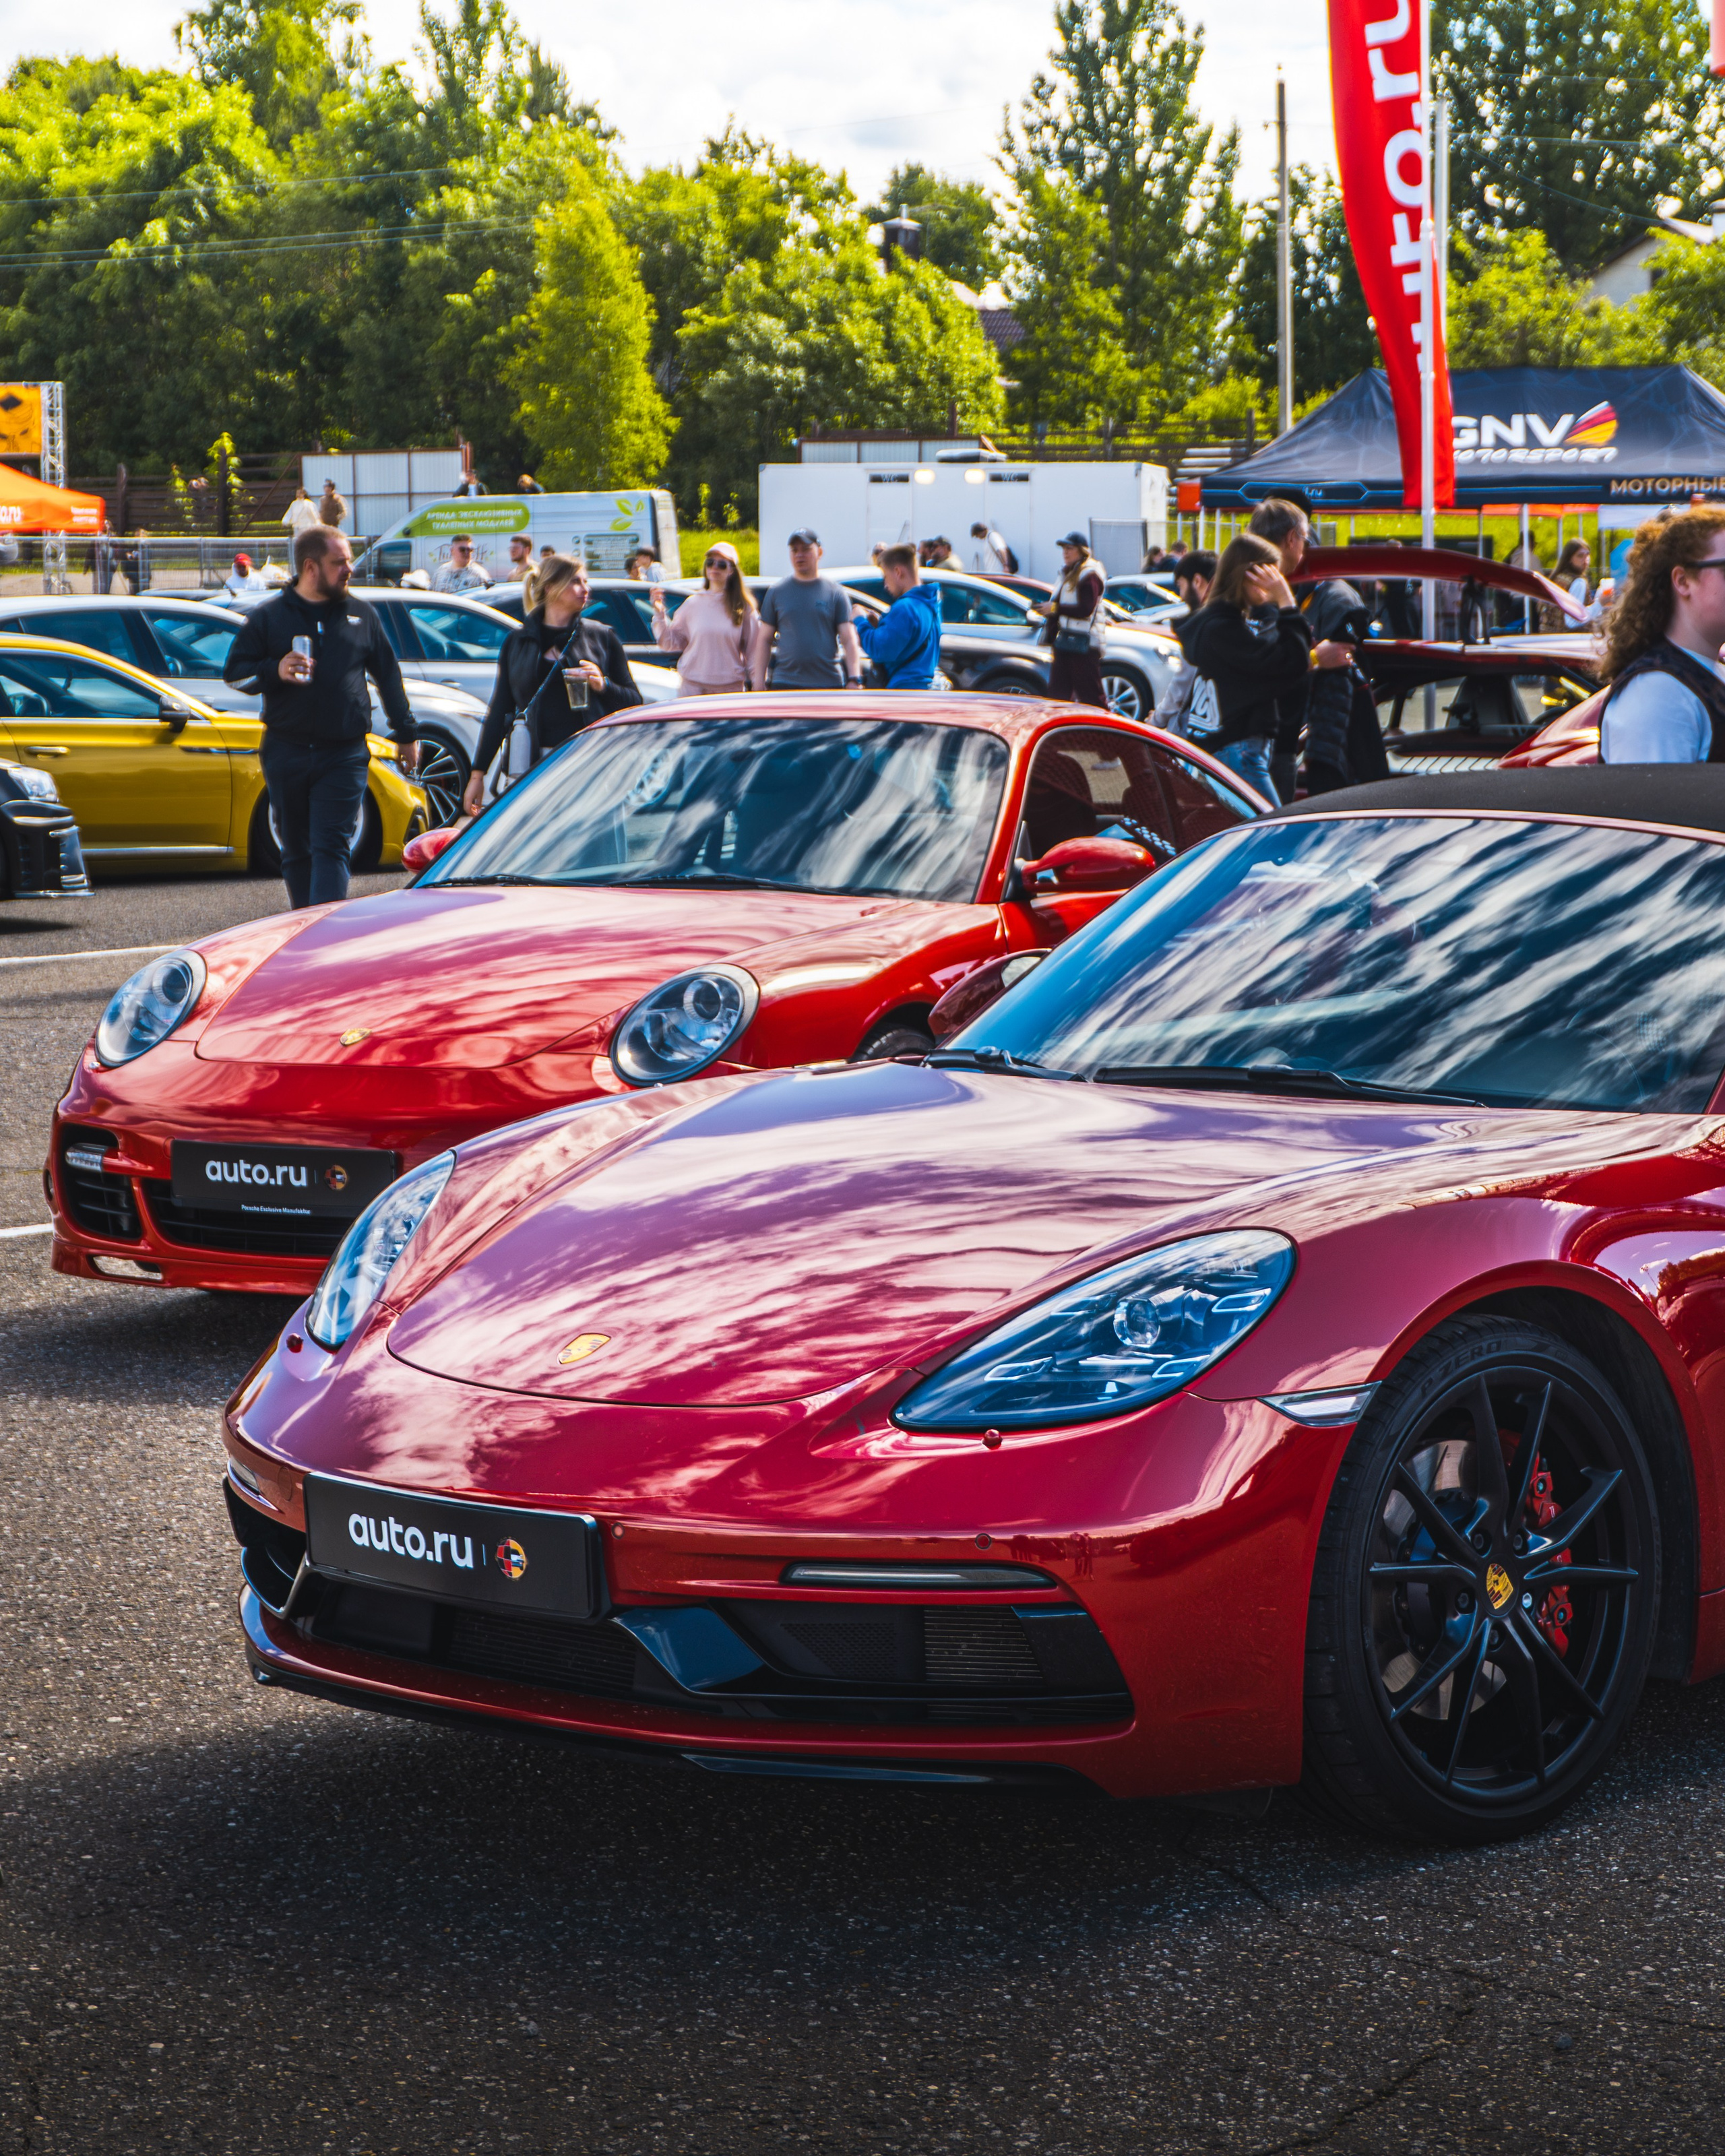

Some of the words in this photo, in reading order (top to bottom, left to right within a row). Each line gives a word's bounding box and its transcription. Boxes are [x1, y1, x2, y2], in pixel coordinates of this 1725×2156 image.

[1451, 414, 1574, 447] GNV
[1453, 447, 1618, 464] OTORSPORT
[427, 512, 456, 520] АРЕНДА
[206, 1160, 307, 1186] auto.ru
[260, 1205, 282, 1213] Exclusive
[1420, 1377, 1433, 1397] P
[1439, 1340, 1501, 1381] ZERO
[348, 1513, 473, 1568] auto.ru
